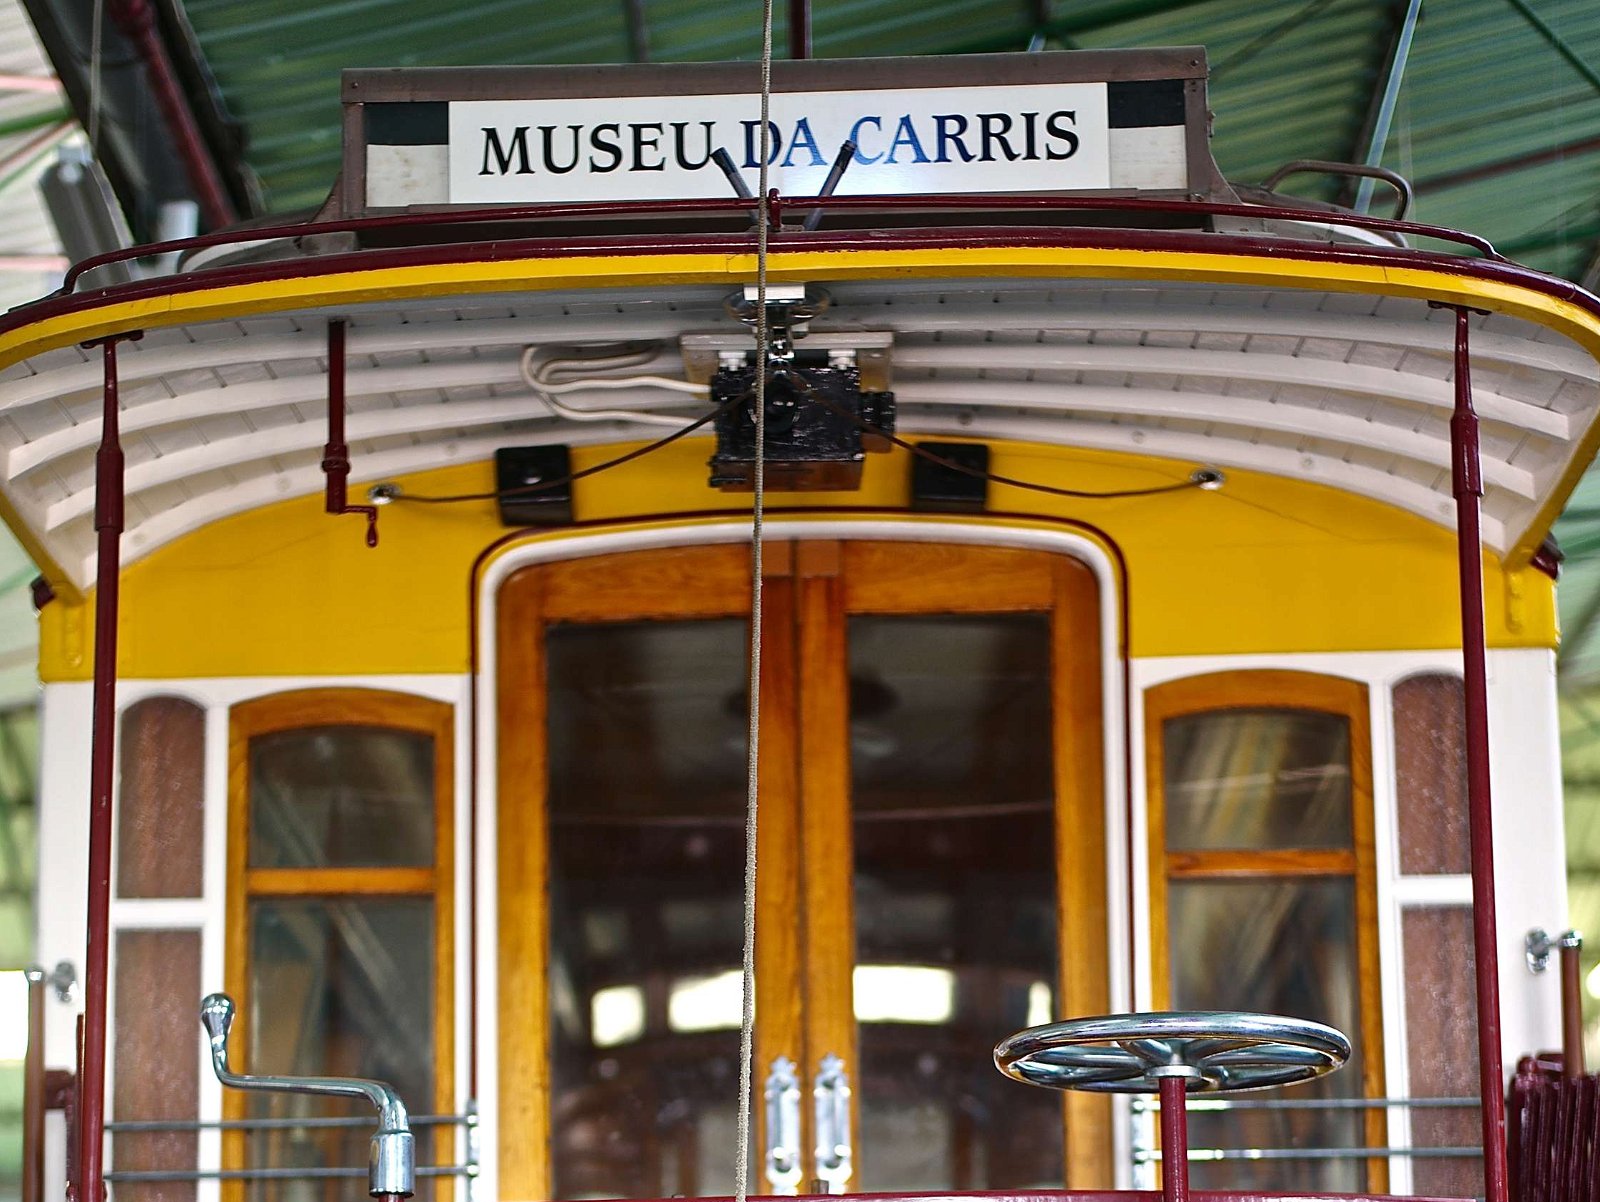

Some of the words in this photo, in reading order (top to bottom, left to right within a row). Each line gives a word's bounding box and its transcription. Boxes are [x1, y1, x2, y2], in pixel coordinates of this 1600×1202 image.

[478, 121, 717, 175] MUSEU
[739, 116, 828, 168] DA
[849, 110, 1080, 166] CARRIS
